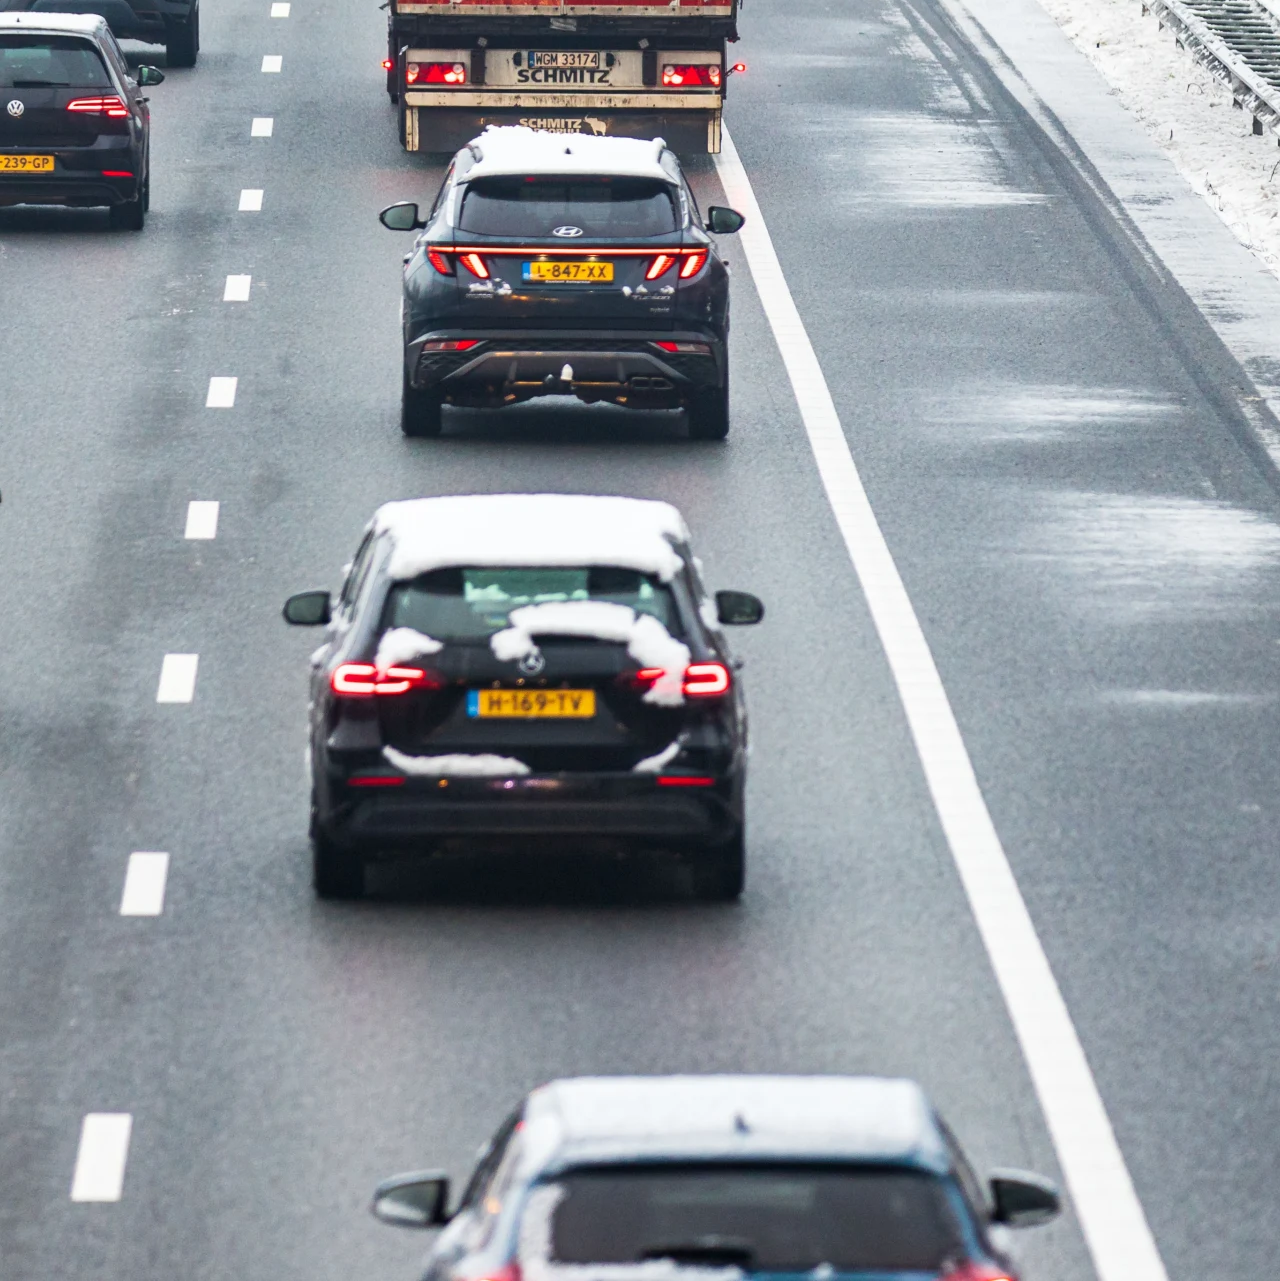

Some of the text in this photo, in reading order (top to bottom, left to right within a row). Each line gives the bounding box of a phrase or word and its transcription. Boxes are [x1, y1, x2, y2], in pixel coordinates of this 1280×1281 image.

[535, 53, 598, 66] WGM 33174
[517, 69, 610, 83] SCHMITZ
[519, 118, 582, 129] SCHMITZ
[537, 264, 606, 278] L-847-XX
[488, 692, 584, 711] H-169-TV
